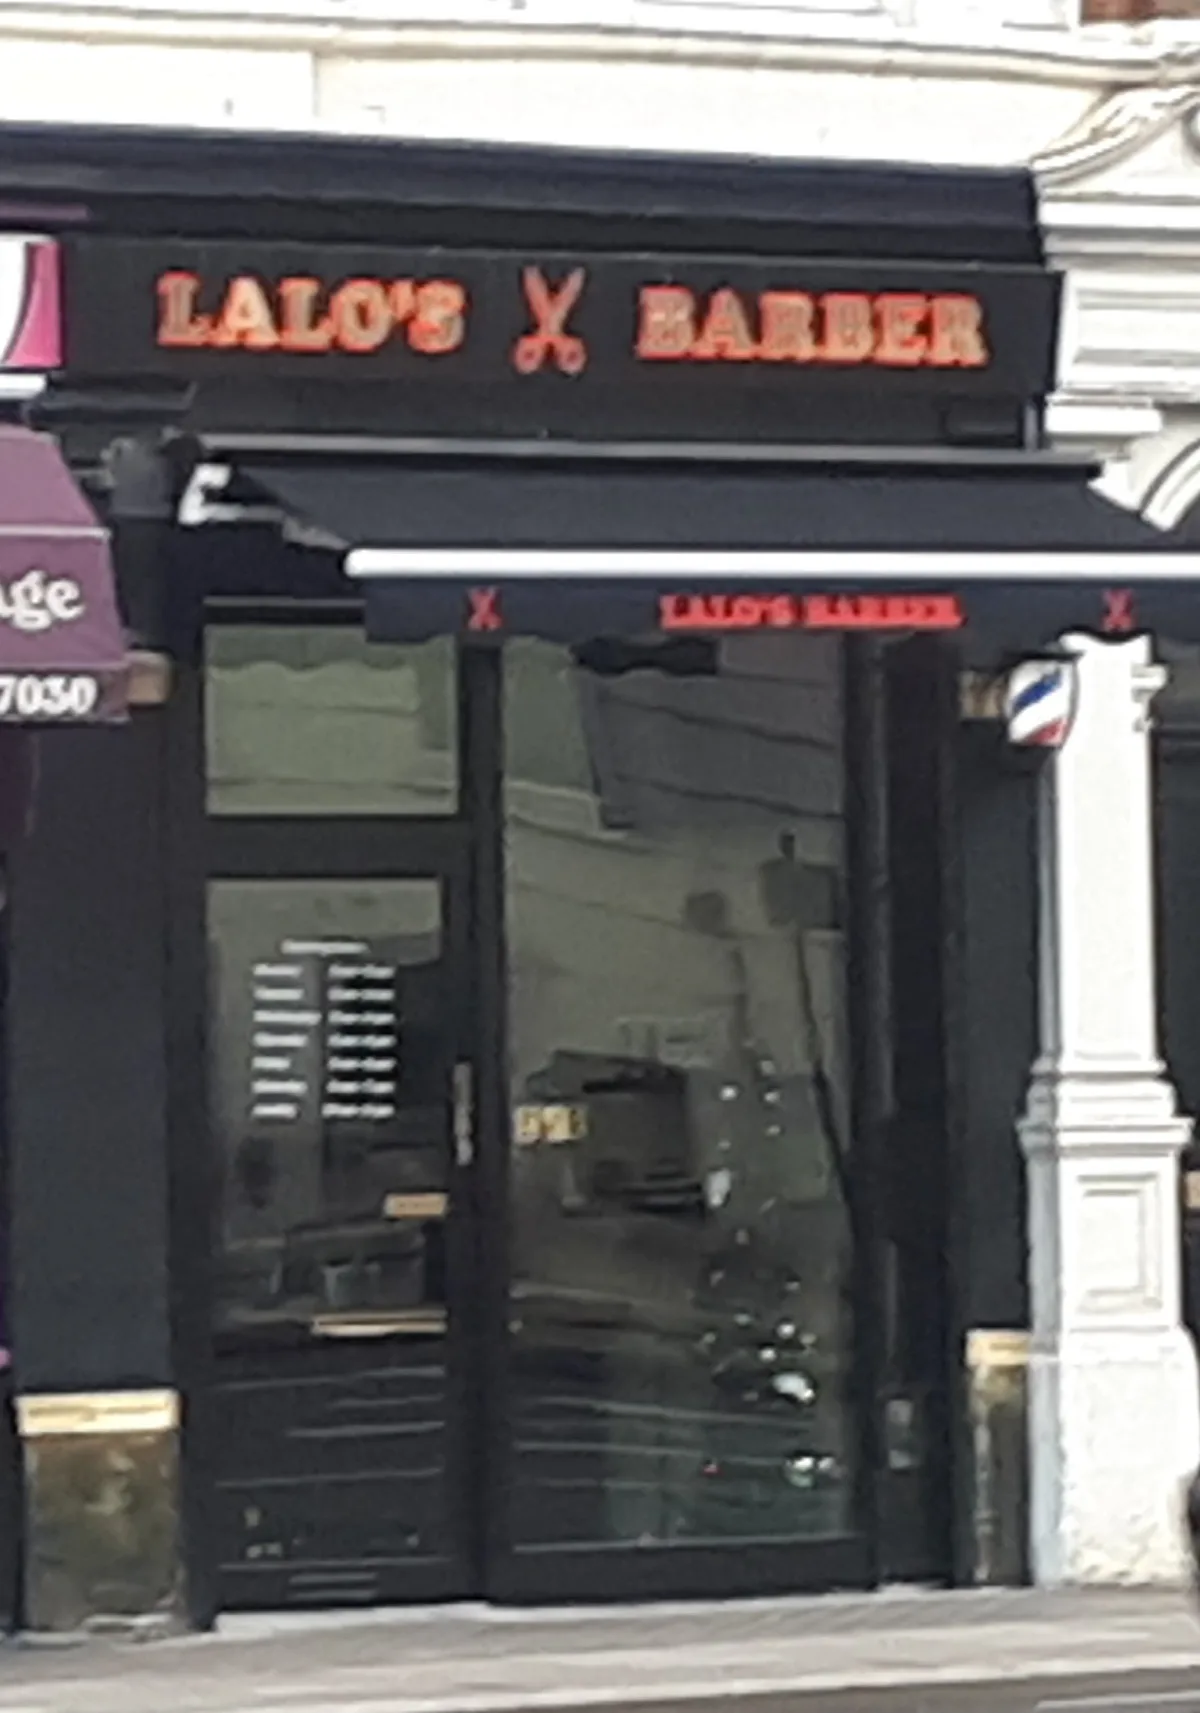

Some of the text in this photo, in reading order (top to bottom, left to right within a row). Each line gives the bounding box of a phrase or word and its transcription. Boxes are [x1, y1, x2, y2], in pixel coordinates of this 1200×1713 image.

[156, 271, 989, 367] LALO'S BARBER
[659, 594, 963, 630] LALO'S BARBER
